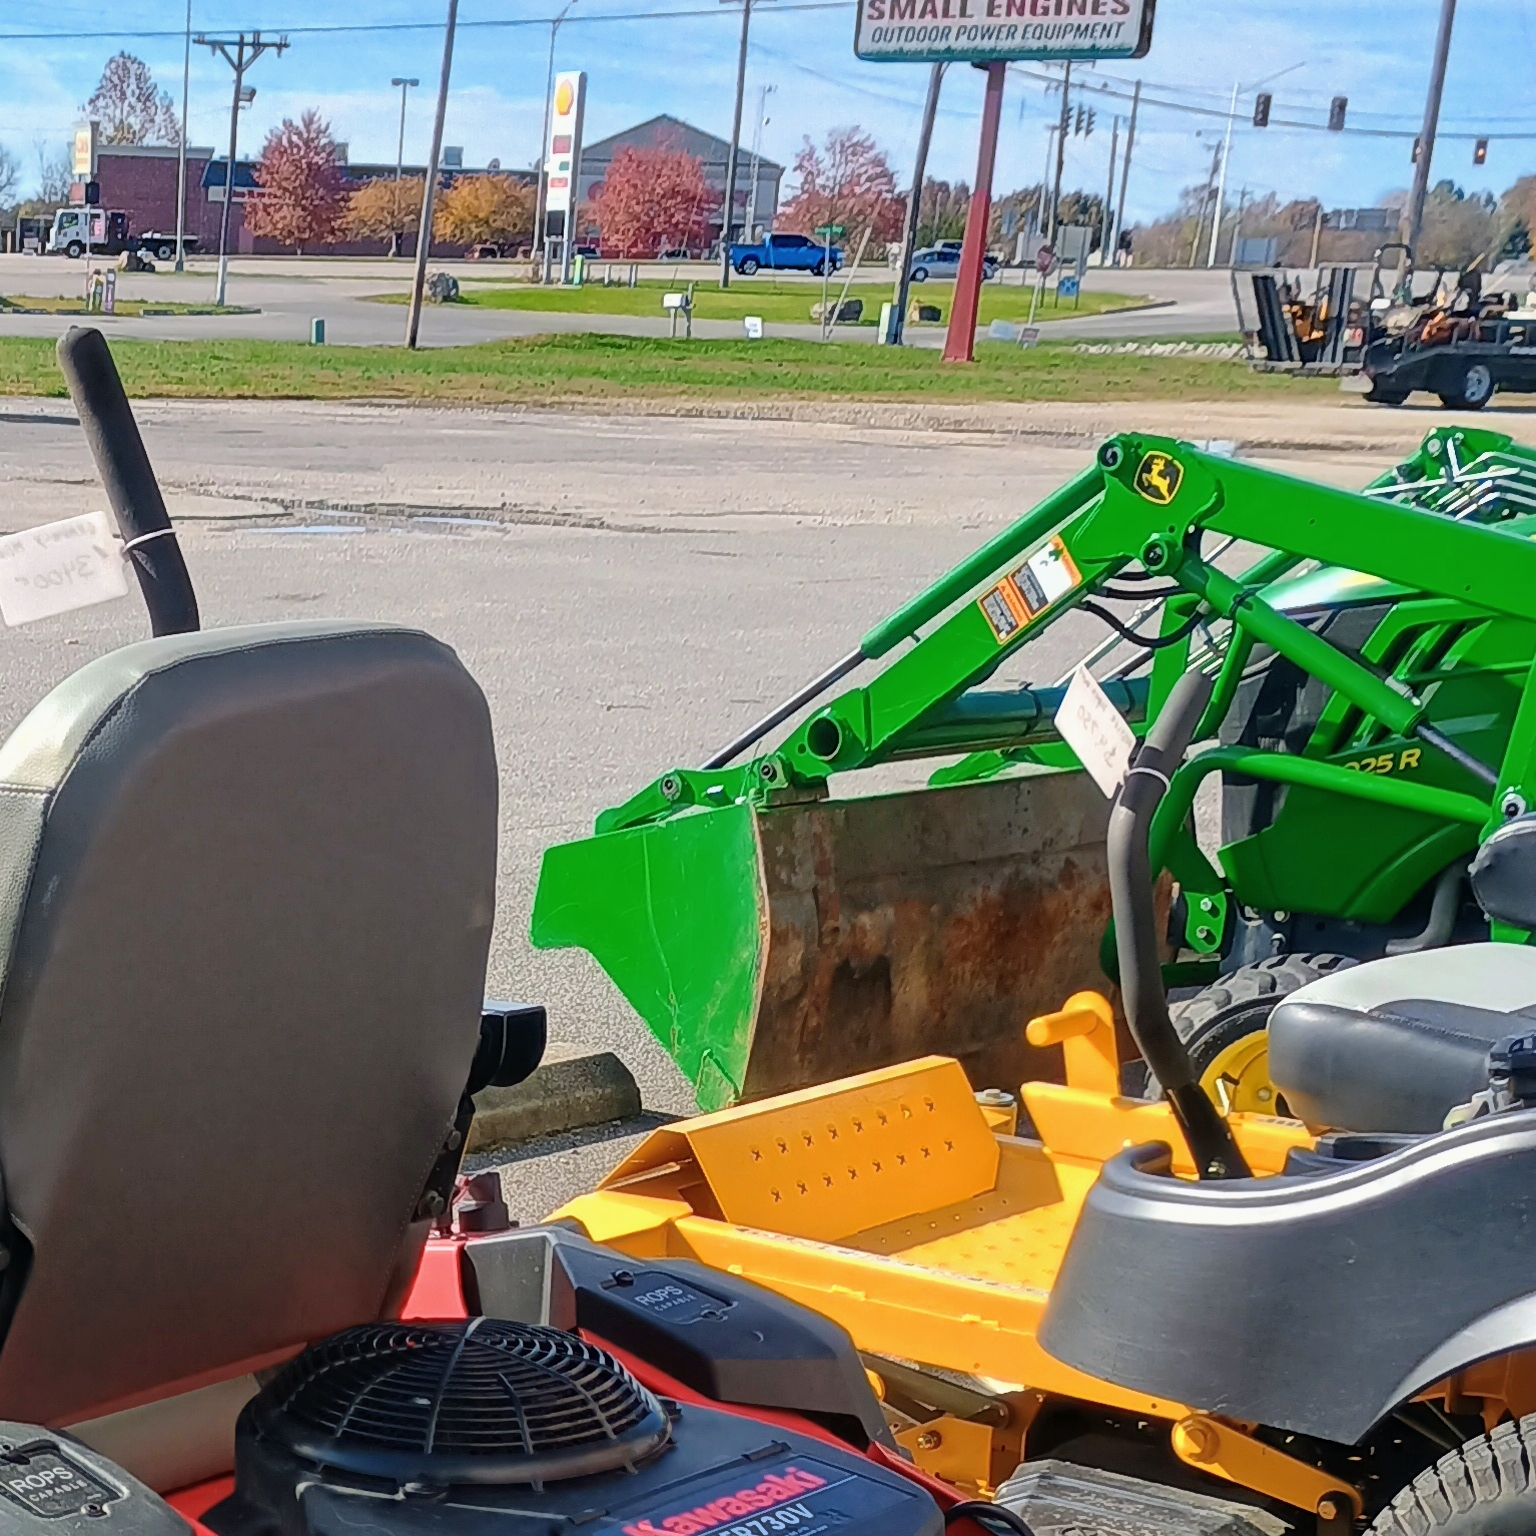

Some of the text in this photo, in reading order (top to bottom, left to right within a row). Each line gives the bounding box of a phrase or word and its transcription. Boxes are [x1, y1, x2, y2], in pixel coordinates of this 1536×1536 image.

[867, 0, 1131, 20] SMALL ENGINES
[871, 21, 1125, 44] OUTDOOR POWER EQUIPMENT
[1399, 748, 1421, 770] R
[634, 1285, 683, 1306] ROPS
[8, 1467, 73, 1493] ROPS
[19, 1480, 88, 1502] CAPABLE
